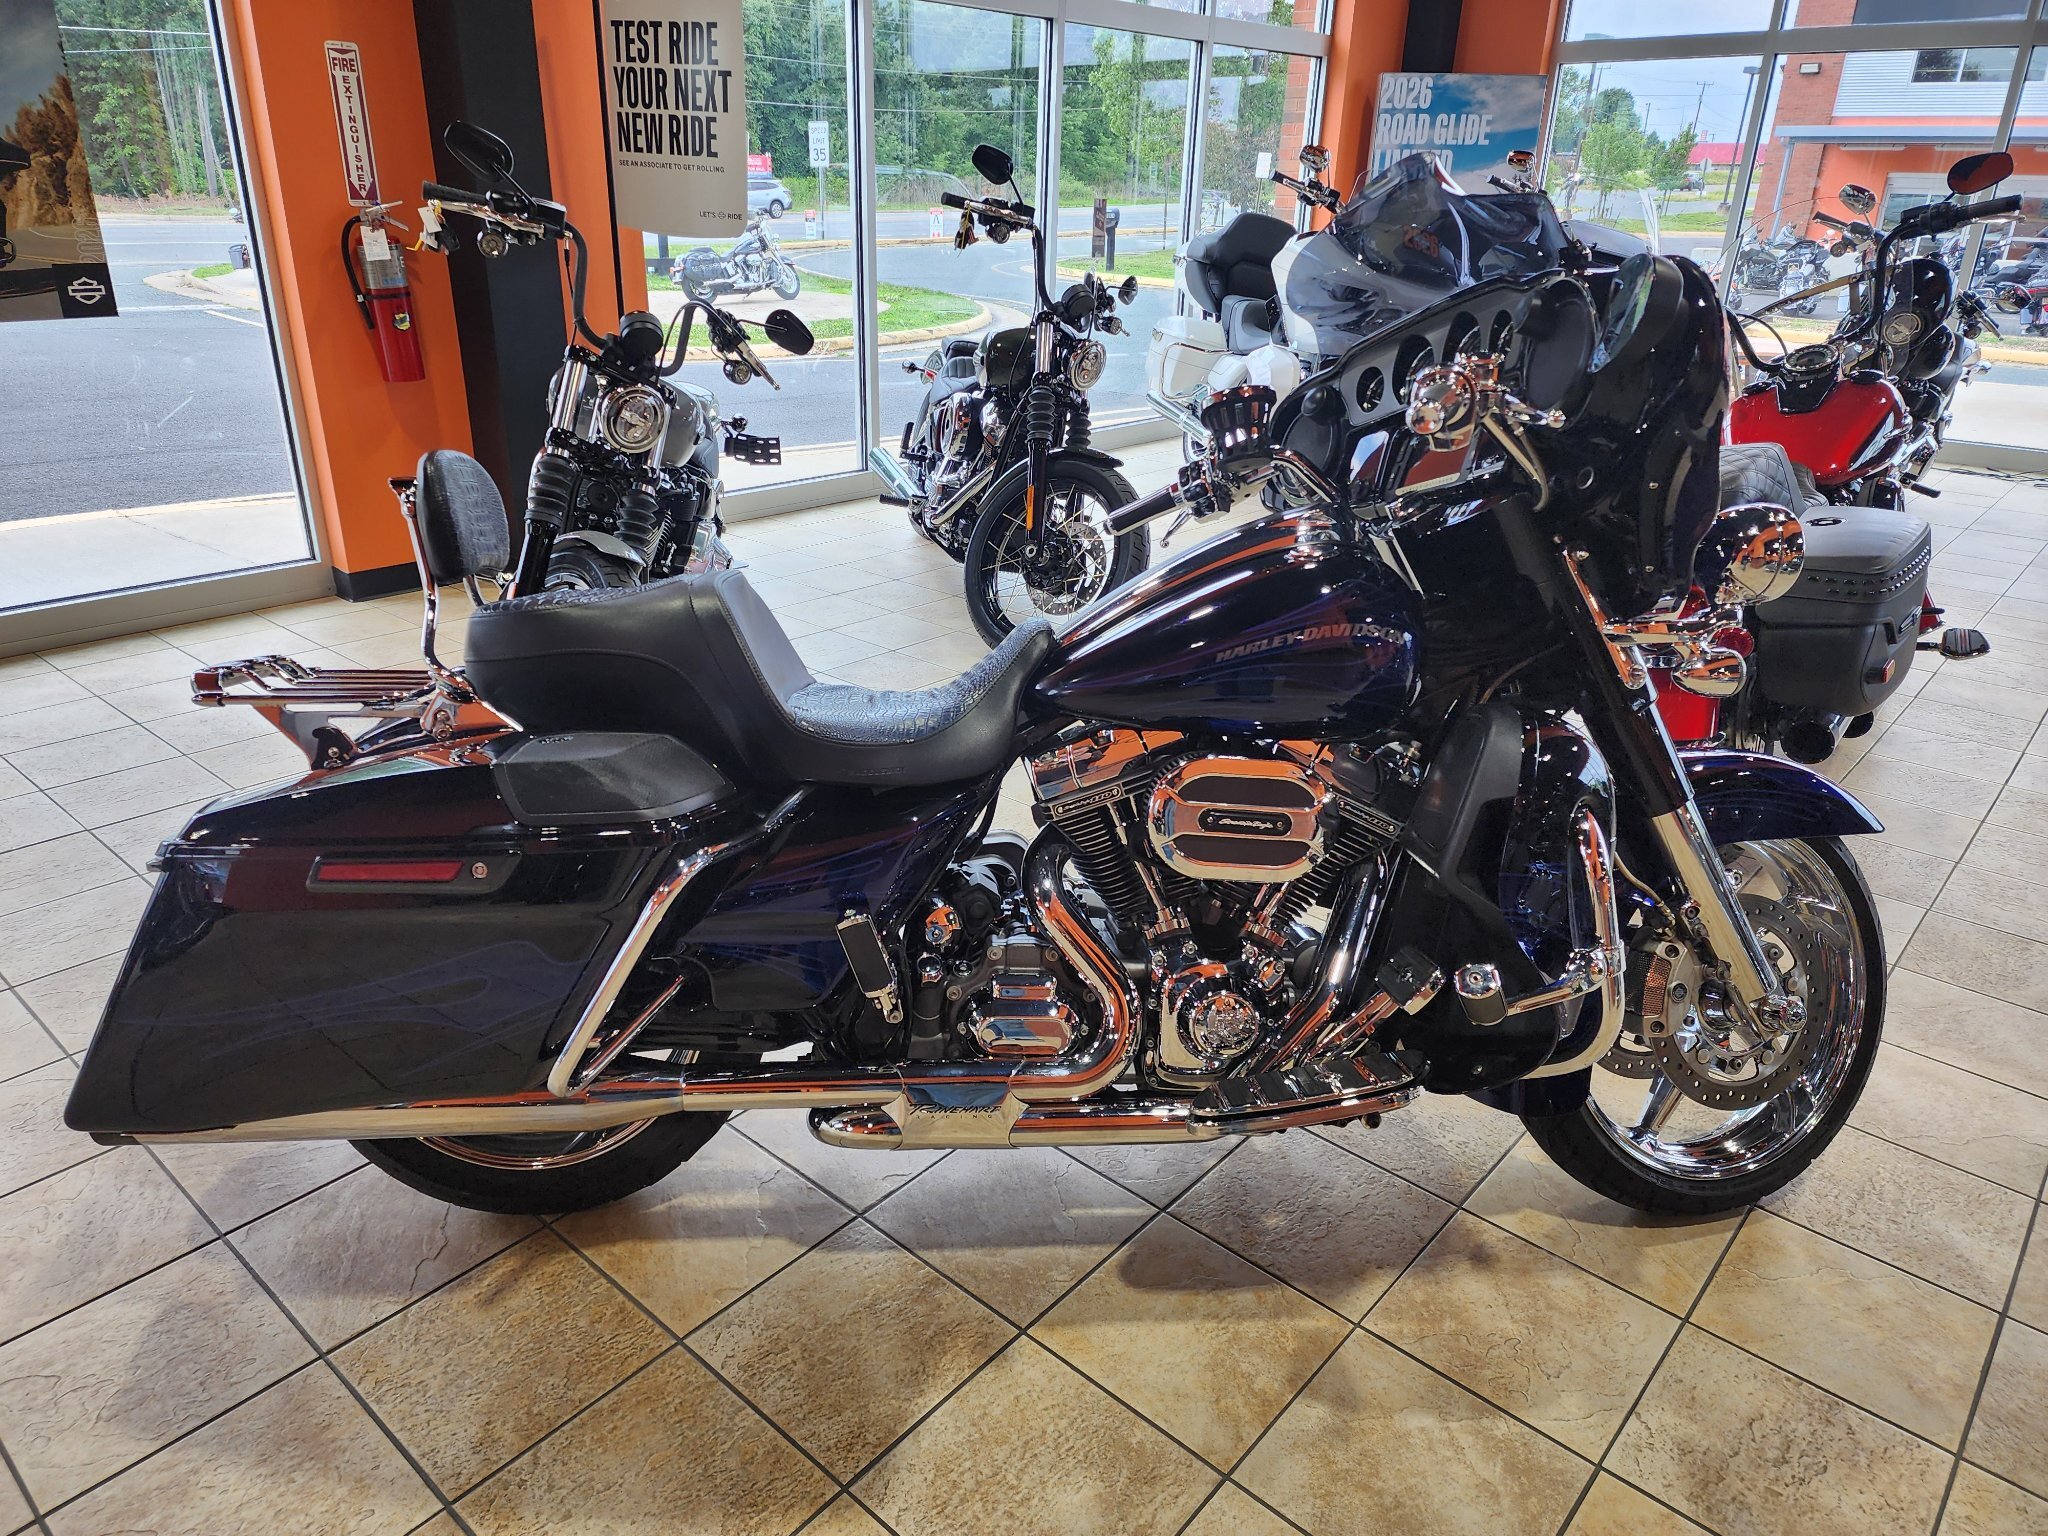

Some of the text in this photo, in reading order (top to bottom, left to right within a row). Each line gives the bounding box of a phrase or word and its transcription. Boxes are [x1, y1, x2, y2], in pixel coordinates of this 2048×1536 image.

[610, 20, 719, 66] TEST RIDE
[331, 56, 357, 73] FIRE
[613, 66, 732, 113] YOUR NEXT
[1381, 76, 1434, 110] 2026
[342, 75, 367, 192] EXTINGUISHER
[616, 111, 719, 159] NEW RIDE
[1376, 113, 1493, 146] ROAD GLIDE
[619, 159, 630, 167] SEE
[630, 160, 639, 168] AN
[640, 160, 673, 170] ASSOCIATE
[696, 165, 725, 174] ROLLING
[813, 148, 827, 162] 35
[699, 211, 716, 219] LET'S
[909, 1103, 1002, 1116] RINEHART
